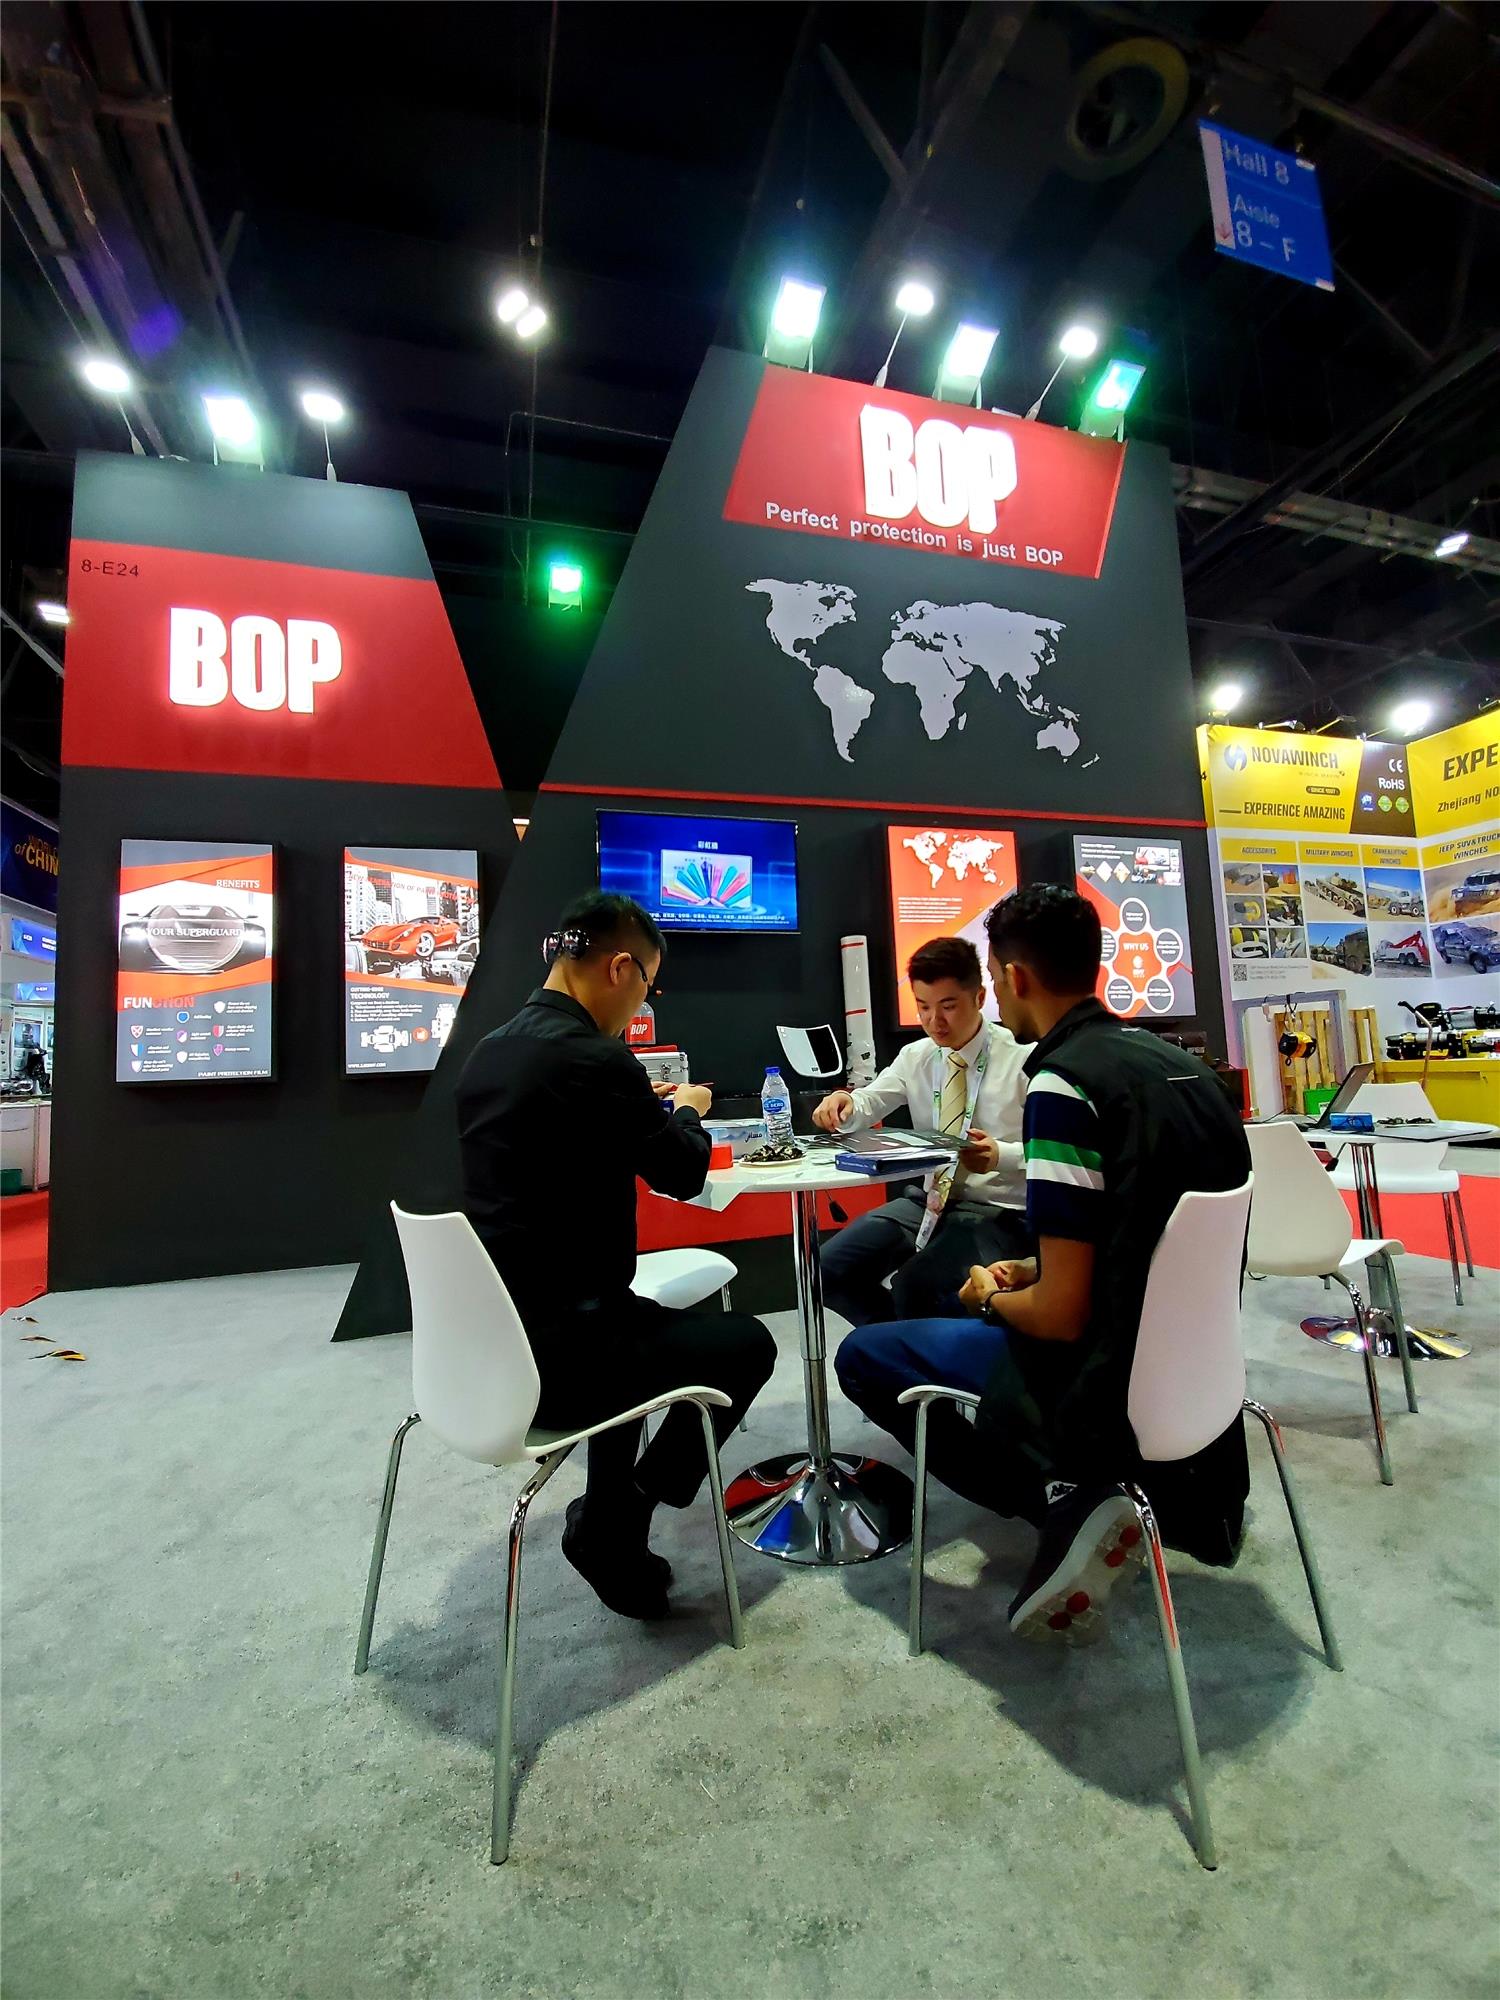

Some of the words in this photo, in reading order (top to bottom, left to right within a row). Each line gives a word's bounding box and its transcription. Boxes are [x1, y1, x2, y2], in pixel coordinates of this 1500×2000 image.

[1222, 139, 1268, 178] Hall
[1275, 160, 1290, 186] 8
[1233, 193, 1281, 229] Aisle
[1235, 220, 1253, 248] 8
[1282, 237, 1297, 262] F
[858, 403, 1018, 535] BOP
[765, 501, 839, 531] Perfect
[850, 519, 947, 549] protection
[956, 533, 974, 554] is
[981, 538, 1017, 560] just
[1025, 544, 1065, 567] BOP
[80, 558, 140, 578] 8-E24
[168, 606, 343, 715] BOP
[1251, 745, 1339, 770] NOVAWINCH
[1443, 742, 1499, 782] EXPE
[1377, 776, 1406, 791] RoHS
[1243, 801, 1301, 818] EXPERIENCE
[1303, 805, 1346, 821] AMAZING
[1437, 793, 1482, 813] Zhejiang
[1305, 848, 1330, 857] MILITARY
[1453, 845, 1489, 860] WINCHES
[215, 879, 261, 889] BENEFITS
[145, 926, 175, 937] YOUR
[1122, 942, 1139, 951] WHY
[1140, 942, 1150, 951] US
[123, 996, 195, 1009] FUNCTION
[630, 1023, 649, 1036] BOP
